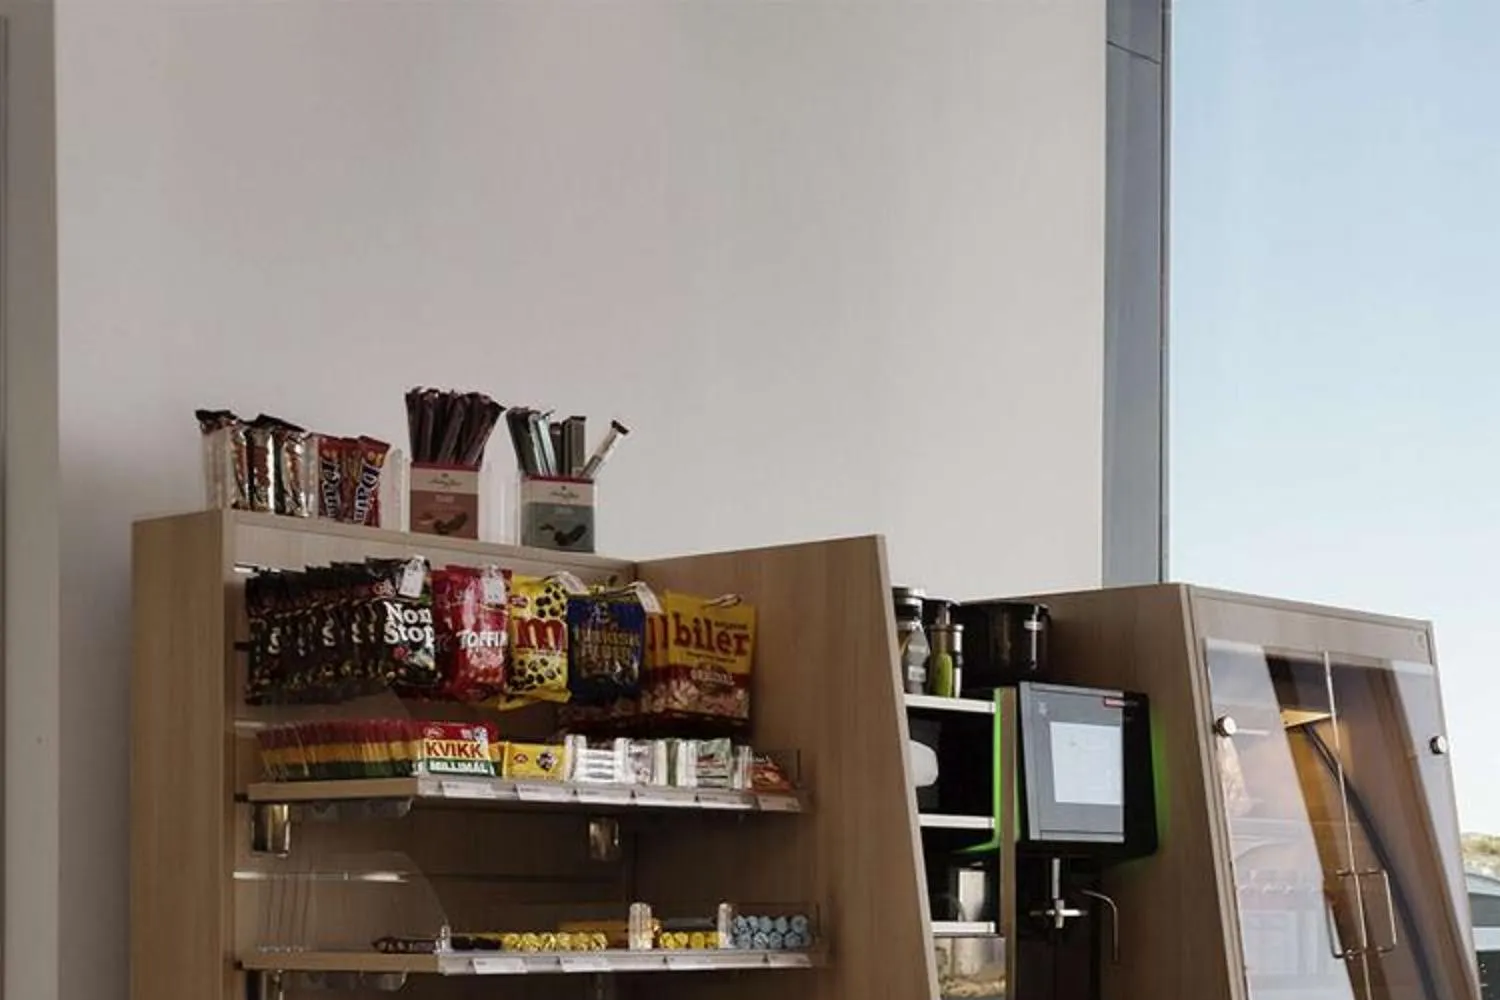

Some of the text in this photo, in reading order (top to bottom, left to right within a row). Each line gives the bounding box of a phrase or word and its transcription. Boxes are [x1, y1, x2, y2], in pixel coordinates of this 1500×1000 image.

[384, 601, 433, 625] Non
[384, 620, 436, 650] Stop
[425, 741, 484, 758] KVIKK
